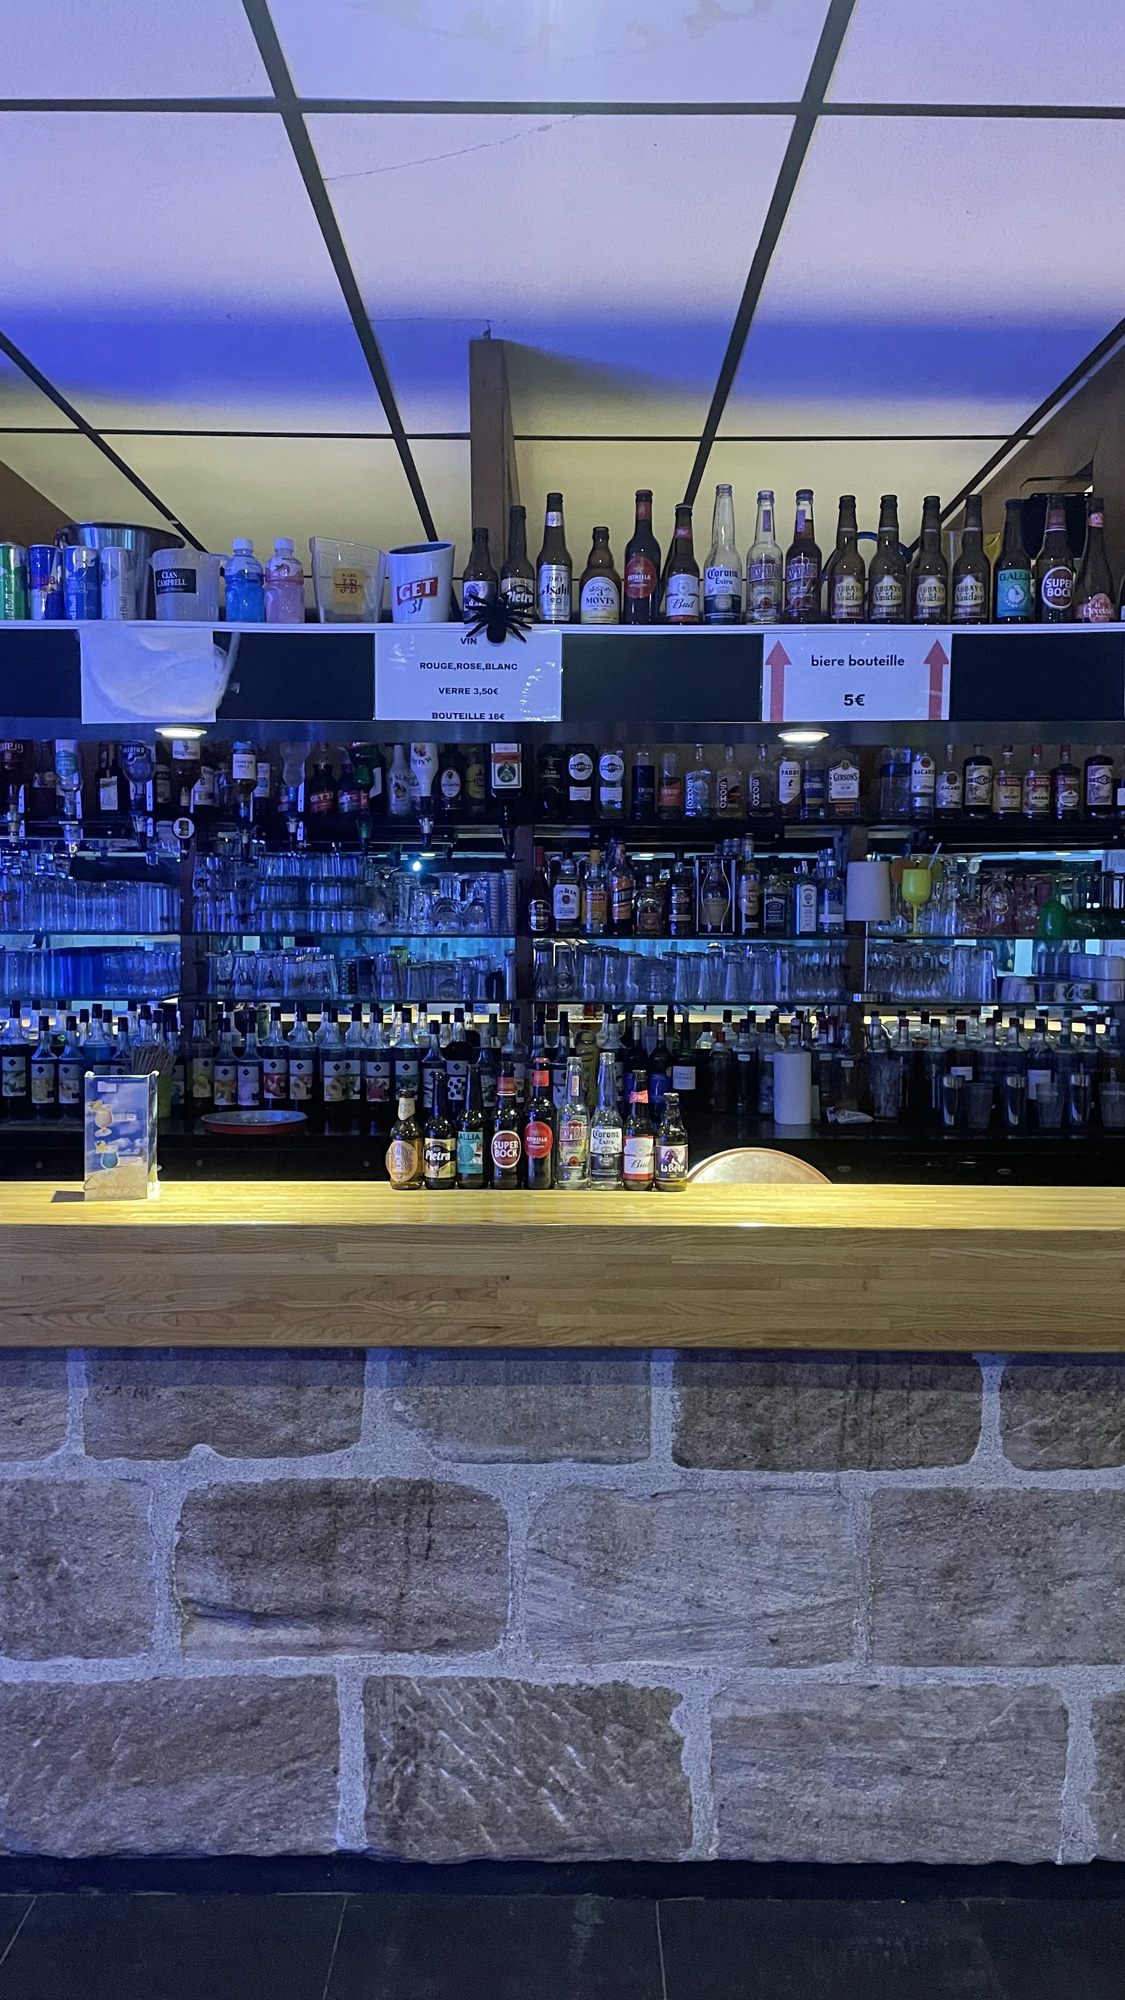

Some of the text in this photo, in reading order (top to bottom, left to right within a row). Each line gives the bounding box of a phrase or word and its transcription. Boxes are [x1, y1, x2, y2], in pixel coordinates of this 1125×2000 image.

[162, 571, 178, 579] CLAN
[707, 568, 739, 580] Corona
[157, 578, 187, 588] CAMPBELL
[1046, 578, 1073, 588] SUPE
[399, 579, 435, 602] GET
[542, 583, 570, 596] Asahi
[407, 598, 423, 614] 31
[586, 597, 615, 605] MONTS
[672, 598, 695, 609] Bud
[460, 637, 478, 645] VIN
[811, 654, 905, 667] biere bouteille
[419, 662, 518, 671] ROUGE,ROSE,BLANC
[438, 687, 499, 696] VERRE 3,50€
[843, 693, 866, 707] 5€
[431, 712, 506, 720] BOUTEILLE 16€
[752, 779, 760, 806] SOHO
[592, 1129, 620, 1140] Corona
[493, 1141, 519, 1149] SUPER
[425, 1149, 450, 1161] Pietra
[495, 1149, 518, 1158] BOCK
[629, 1159, 650, 1169] Bud
